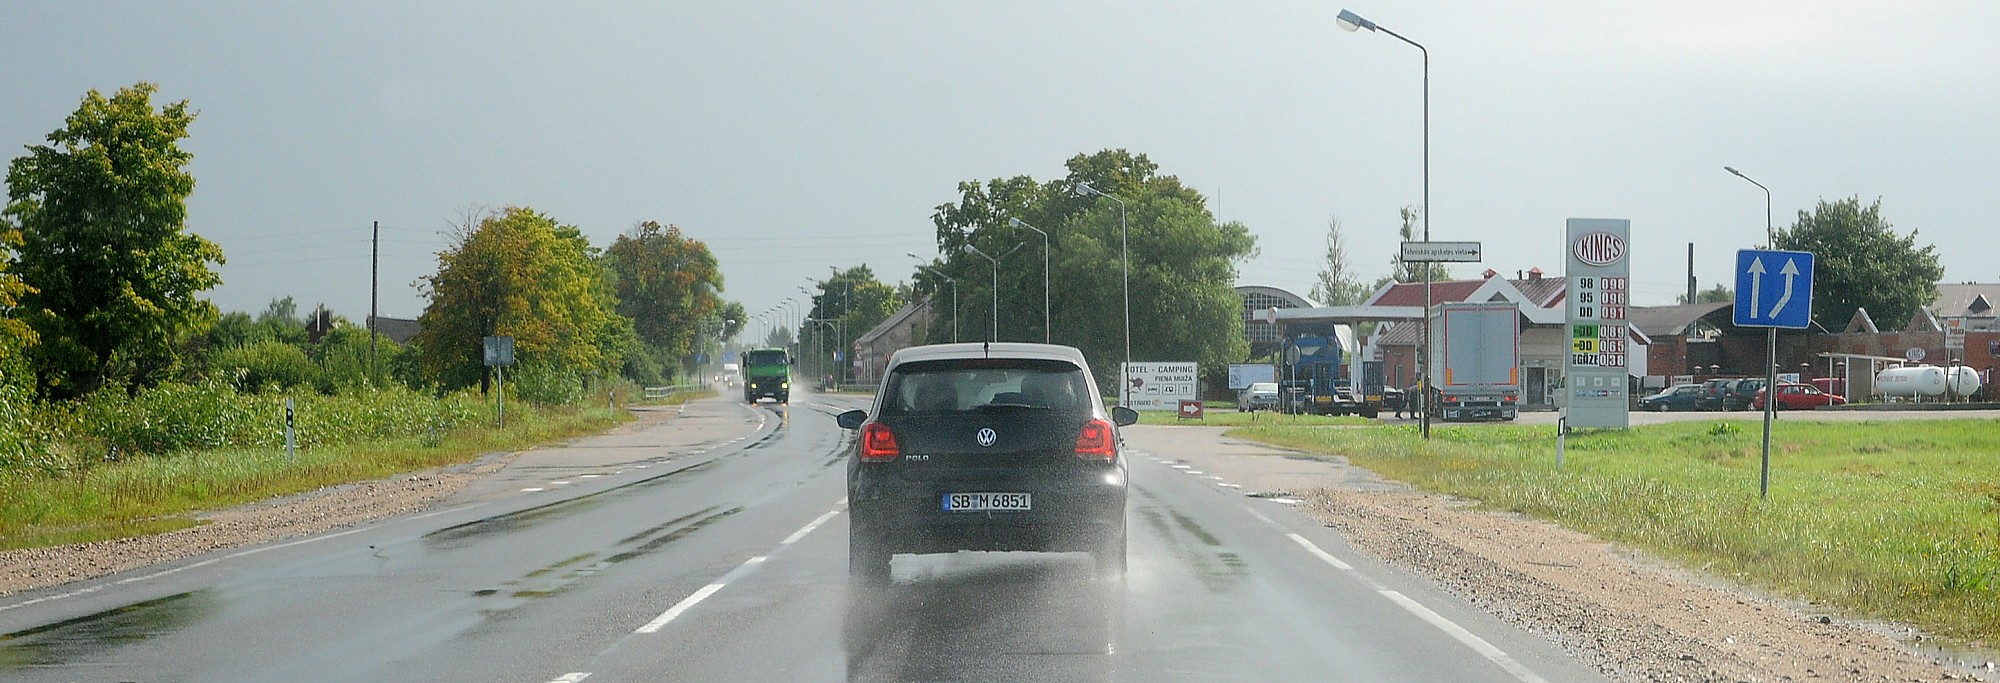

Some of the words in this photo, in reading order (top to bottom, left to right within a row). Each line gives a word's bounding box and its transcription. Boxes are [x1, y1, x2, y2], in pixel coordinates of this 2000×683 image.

[1581, 234, 1621, 262] KINGS
[1580, 278, 1593, 289] 98
[1601, 278, 1625, 290] 098
[1580, 292, 1593, 303] 95
[1601, 292, 1625, 304] 096
[1580, 307, 1593, 318] DD
[1601, 306, 1625, 319] 091
[1600, 326, 1624, 338] 089
[1600, 340, 1624, 352] 065
[1600, 354, 1624, 366] 038
[1158, 365, 1193, 374] CAMPING
[952, 495, 970, 508] SB
[980, 495, 988, 508] M
[992, 495, 1028, 508] 6851
